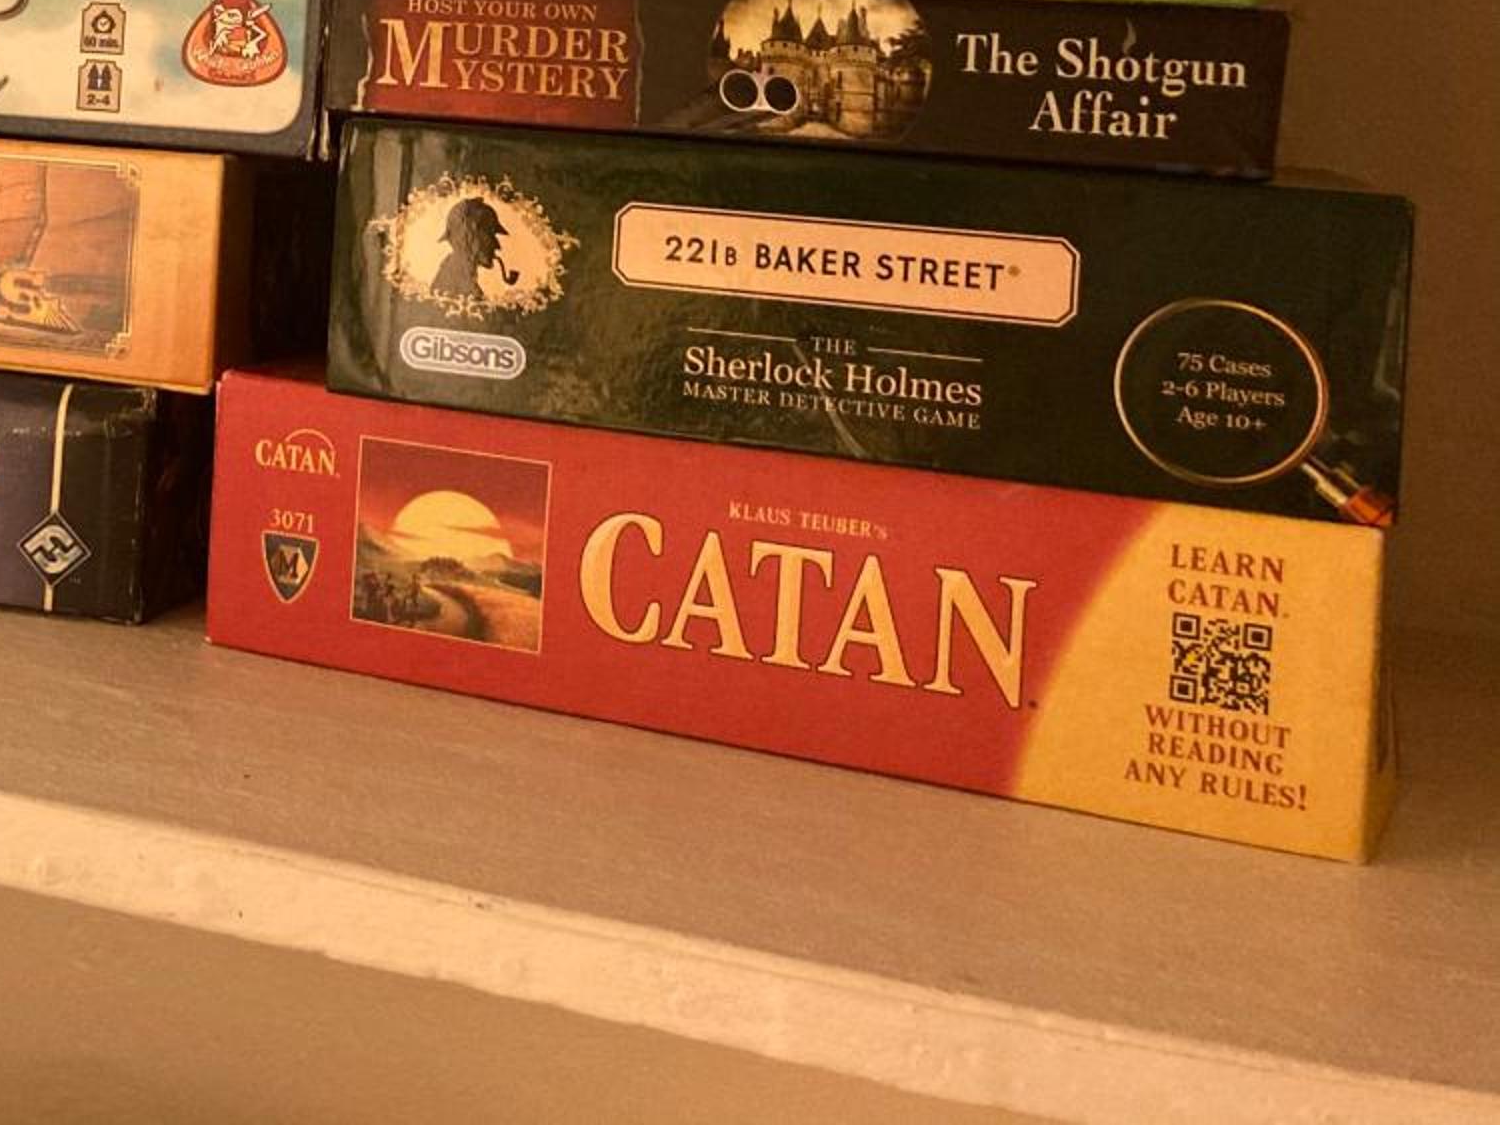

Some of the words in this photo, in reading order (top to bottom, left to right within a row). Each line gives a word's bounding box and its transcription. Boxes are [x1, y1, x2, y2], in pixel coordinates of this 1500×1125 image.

[473, 0, 536, 21] YOUR
[544, 4, 598, 23] OWN
[376, 18, 629, 88] MURDER
[957, 32, 1039, 76] The
[1056, 37, 1248, 98] Shotgun
[86, 93, 111, 107] 2-4
[1029, 89, 1178, 140] Affair
[665, 235, 738, 267] 221B
[756, 243, 861, 279] BAKER
[411, 335, 515, 369] Gibsons
[811, 336, 857, 356] THE
[1176, 351, 1204, 373] 75
[1208, 354, 1272, 377] Cases
[683, 346, 834, 391] Sherlock
[845, 364, 983, 407] Holmes
[1160, 380, 1199, 399] 2-6
[1205, 380, 1285, 408] Players
[682, 381, 771, 407] MASTER
[779, 390, 905, 422] DETECTIVE
[913, 407, 982, 430] GAME
[1176, 405, 1219, 430] Age
[1225, 413, 1267, 430] 10+
[254, 438, 337, 476] CATAN
[270, 509, 314, 534] 3071
[729, 501, 792, 528] KLAUS
[799, 510, 888, 540] TEUBER'S
[1169, 543, 1285, 584] LEARN
[579, 511, 1038, 709] CATAN
[1167, 579, 1282, 619] CATAN
[1143, 703, 1292, 750] WITHOUT
[1147, 731, 1284, 776] READING
[1123, 758, 1187, 789] ANY
[1199, 771, 1308, 812] RULES!
